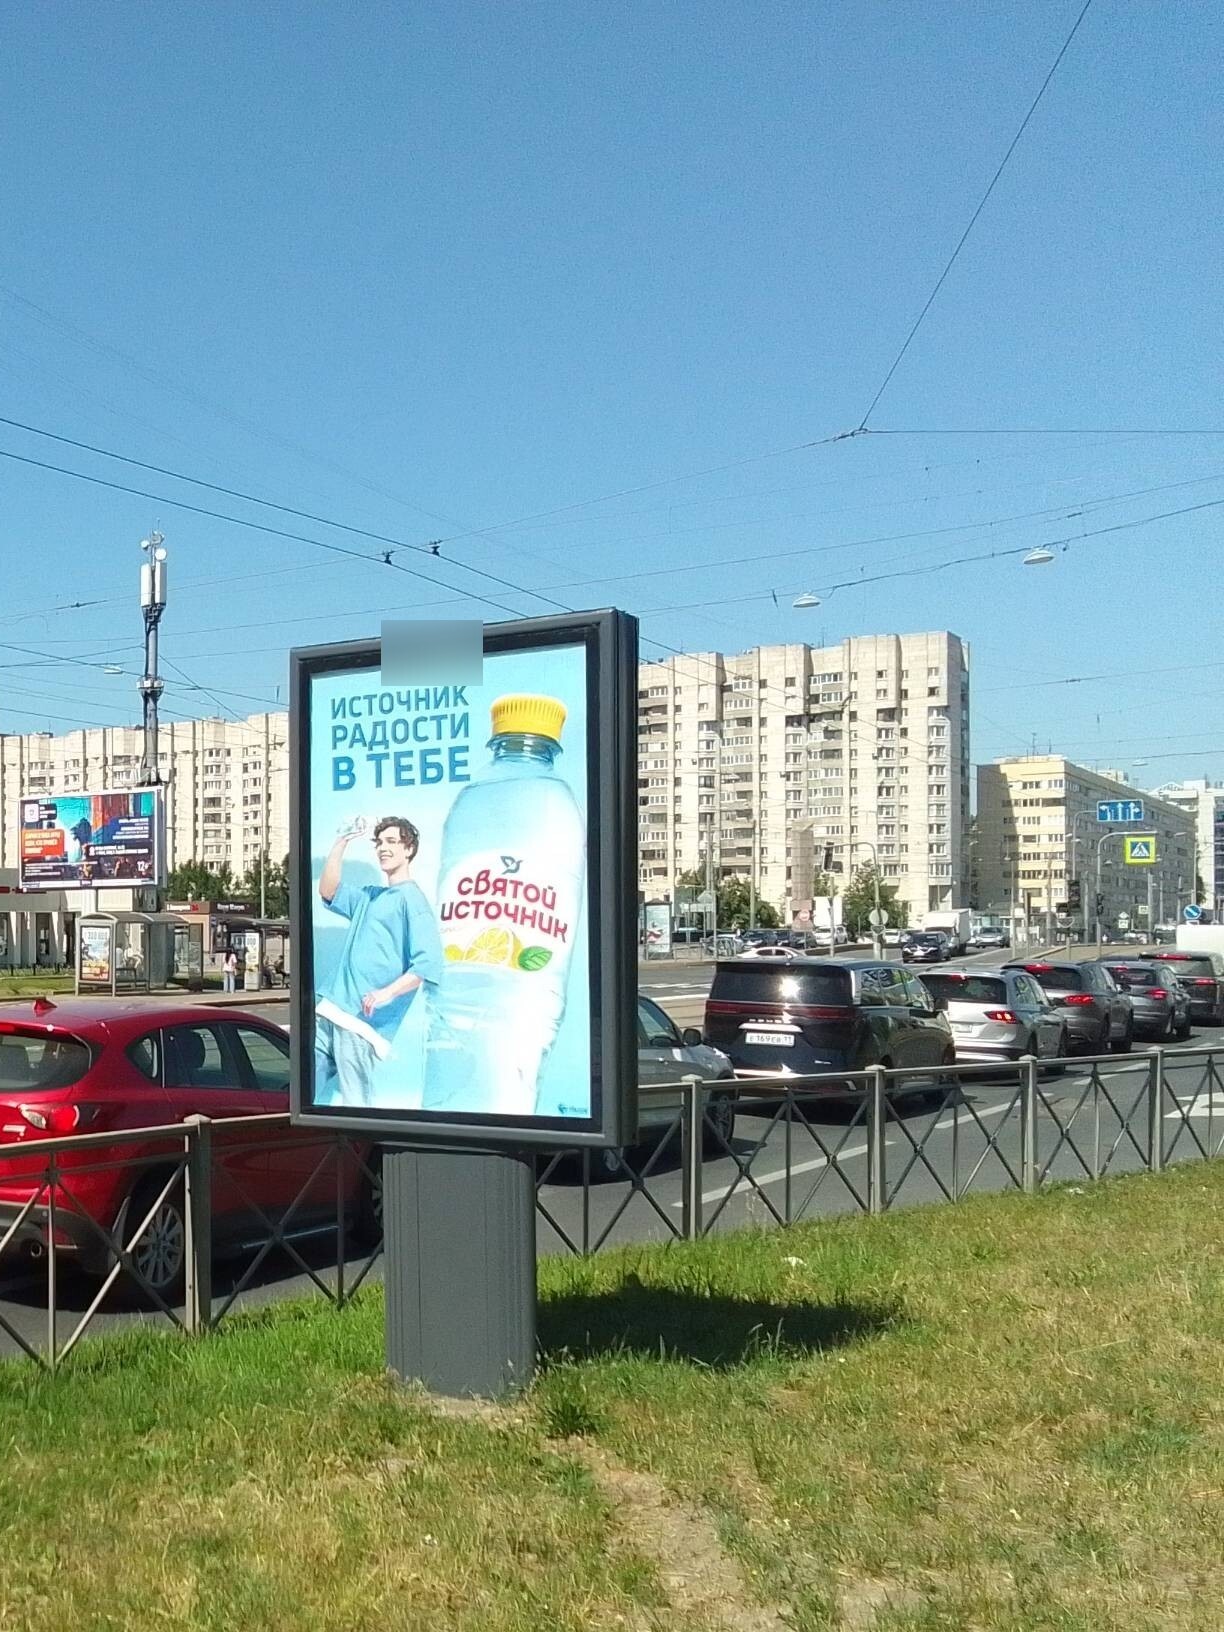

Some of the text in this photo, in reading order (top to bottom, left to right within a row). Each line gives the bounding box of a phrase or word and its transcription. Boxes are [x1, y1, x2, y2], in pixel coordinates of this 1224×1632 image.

[330, 685, 469, 720] ИСТОЧНИК
[331, 712, 469, 751] РАДОСТИ
[332, 745, 471, 791] В ТЕБЕ
